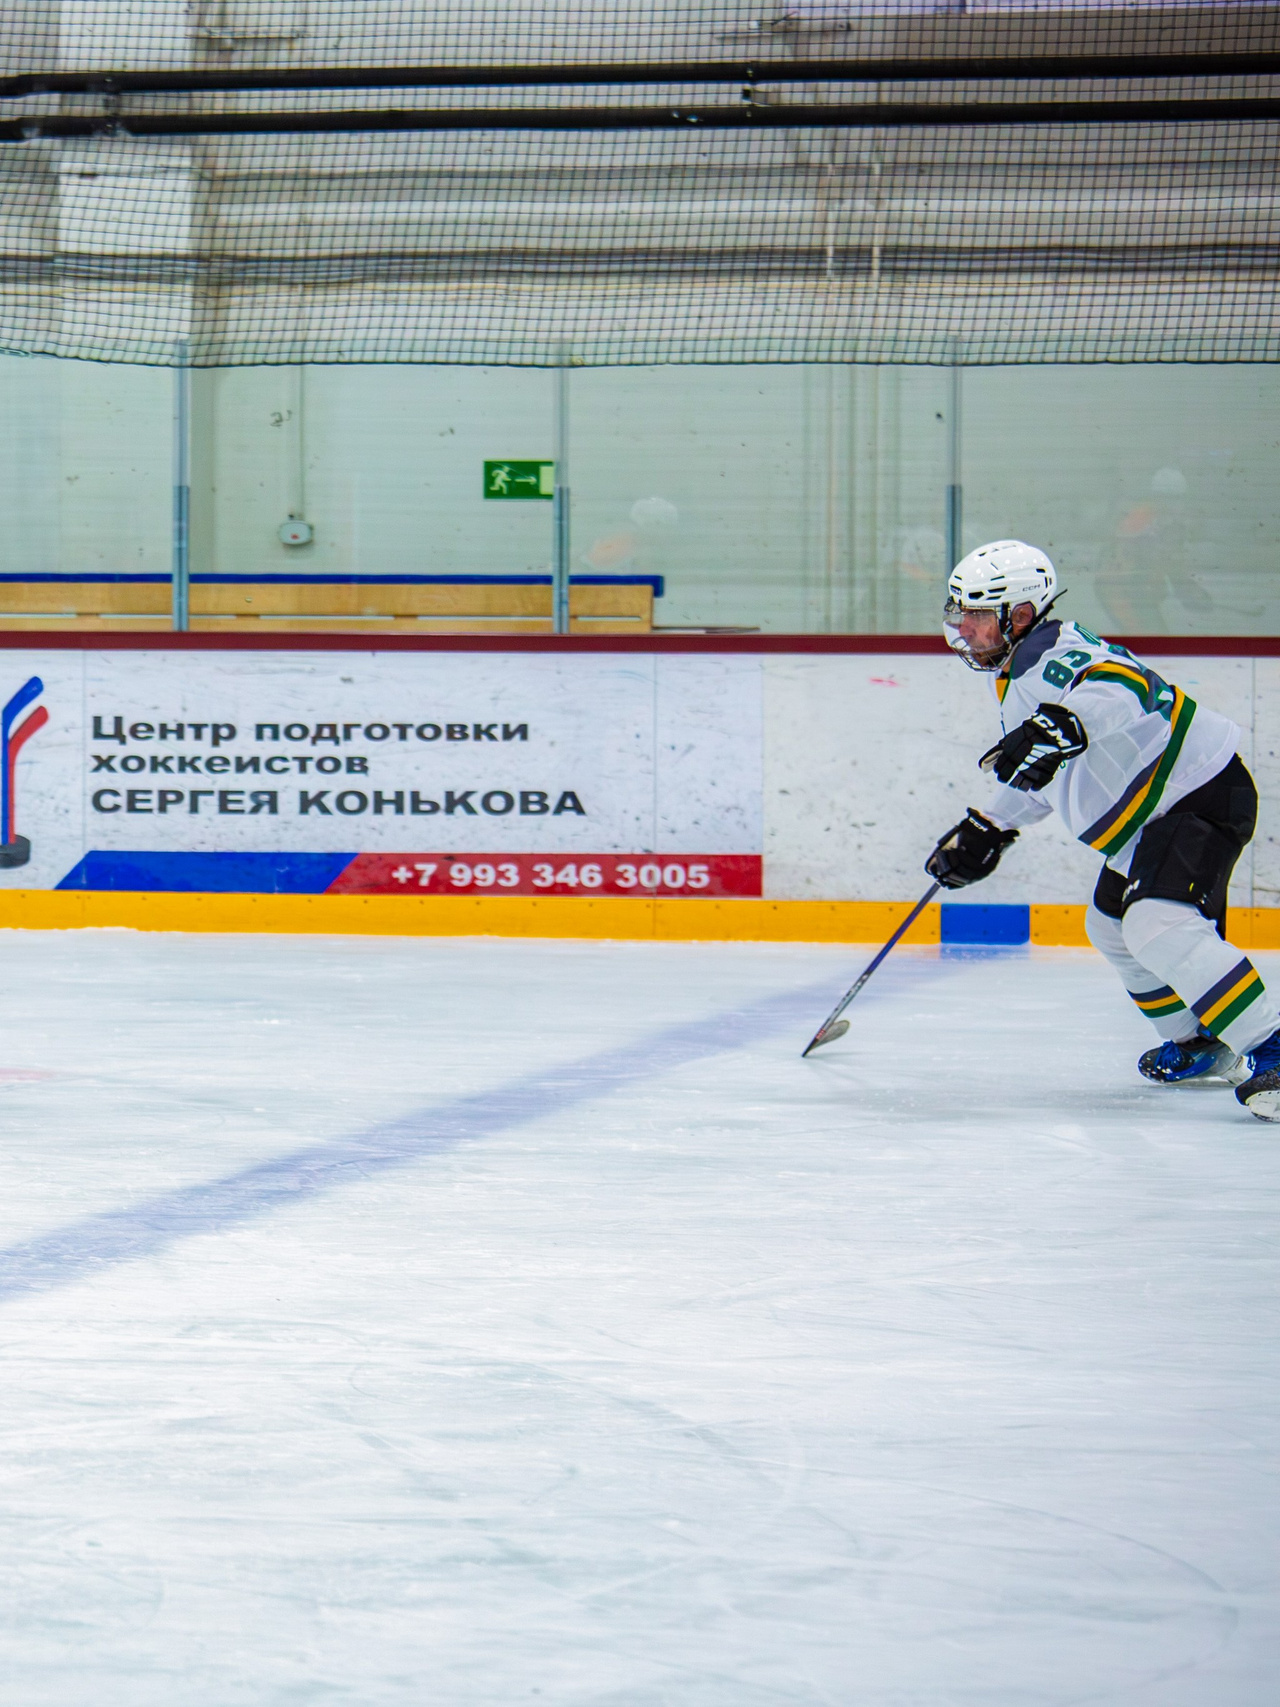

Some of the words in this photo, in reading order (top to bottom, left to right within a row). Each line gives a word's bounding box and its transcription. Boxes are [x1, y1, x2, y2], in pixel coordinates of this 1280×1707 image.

[92, 715, 237, 747] Центр
[255, 722, 529, 746] подготовки
[1031, 712, 1072, 747] CM
[91, 754, 368, 775] хоккеистов
[92, 789, 278, 815] СЕРГЕЯ
[299, 790, 586, 816] КОНЬКОВА
[392, 863, 439, 887] +7
[449, 863, 519, 888] 993
[532, 863, 602, 888] 346
[615, 863, 710, 889] 3005
